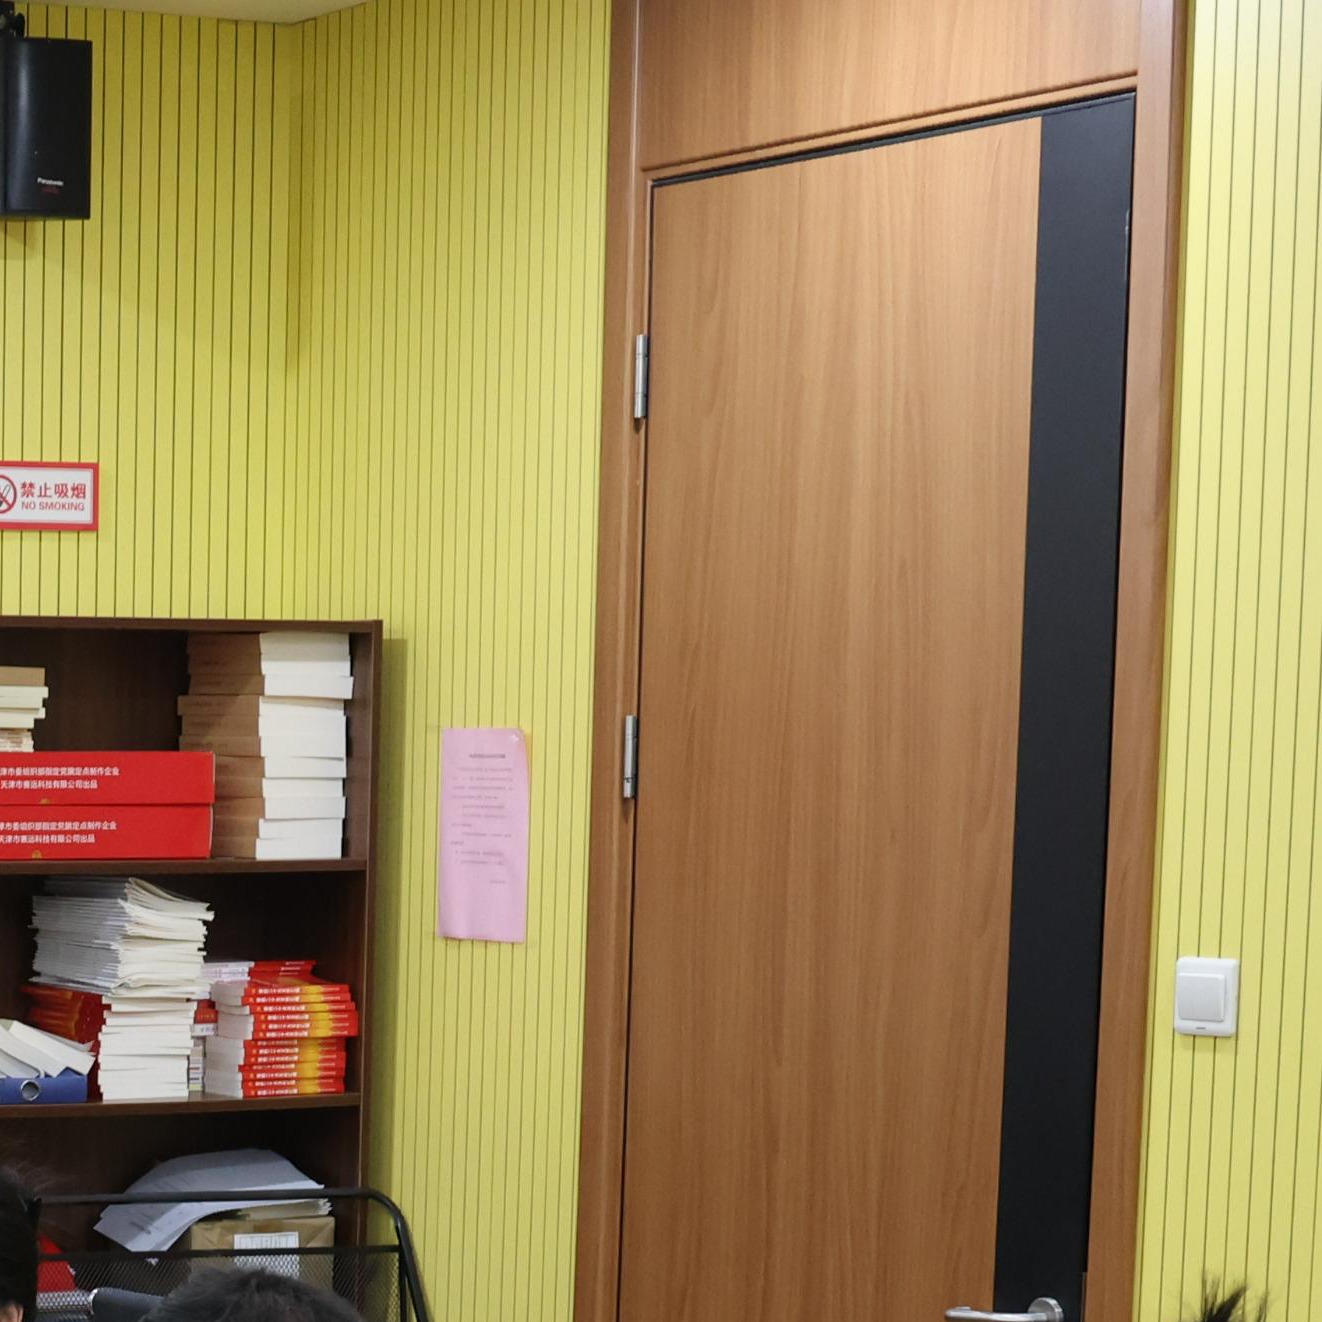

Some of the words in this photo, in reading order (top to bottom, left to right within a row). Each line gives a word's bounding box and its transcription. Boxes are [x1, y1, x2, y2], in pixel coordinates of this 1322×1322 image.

[20, 481, 86, 499] 禁止吸烟
[21, 501, 36, 510] NO
[39, 501, 85, 511] SMOKING
